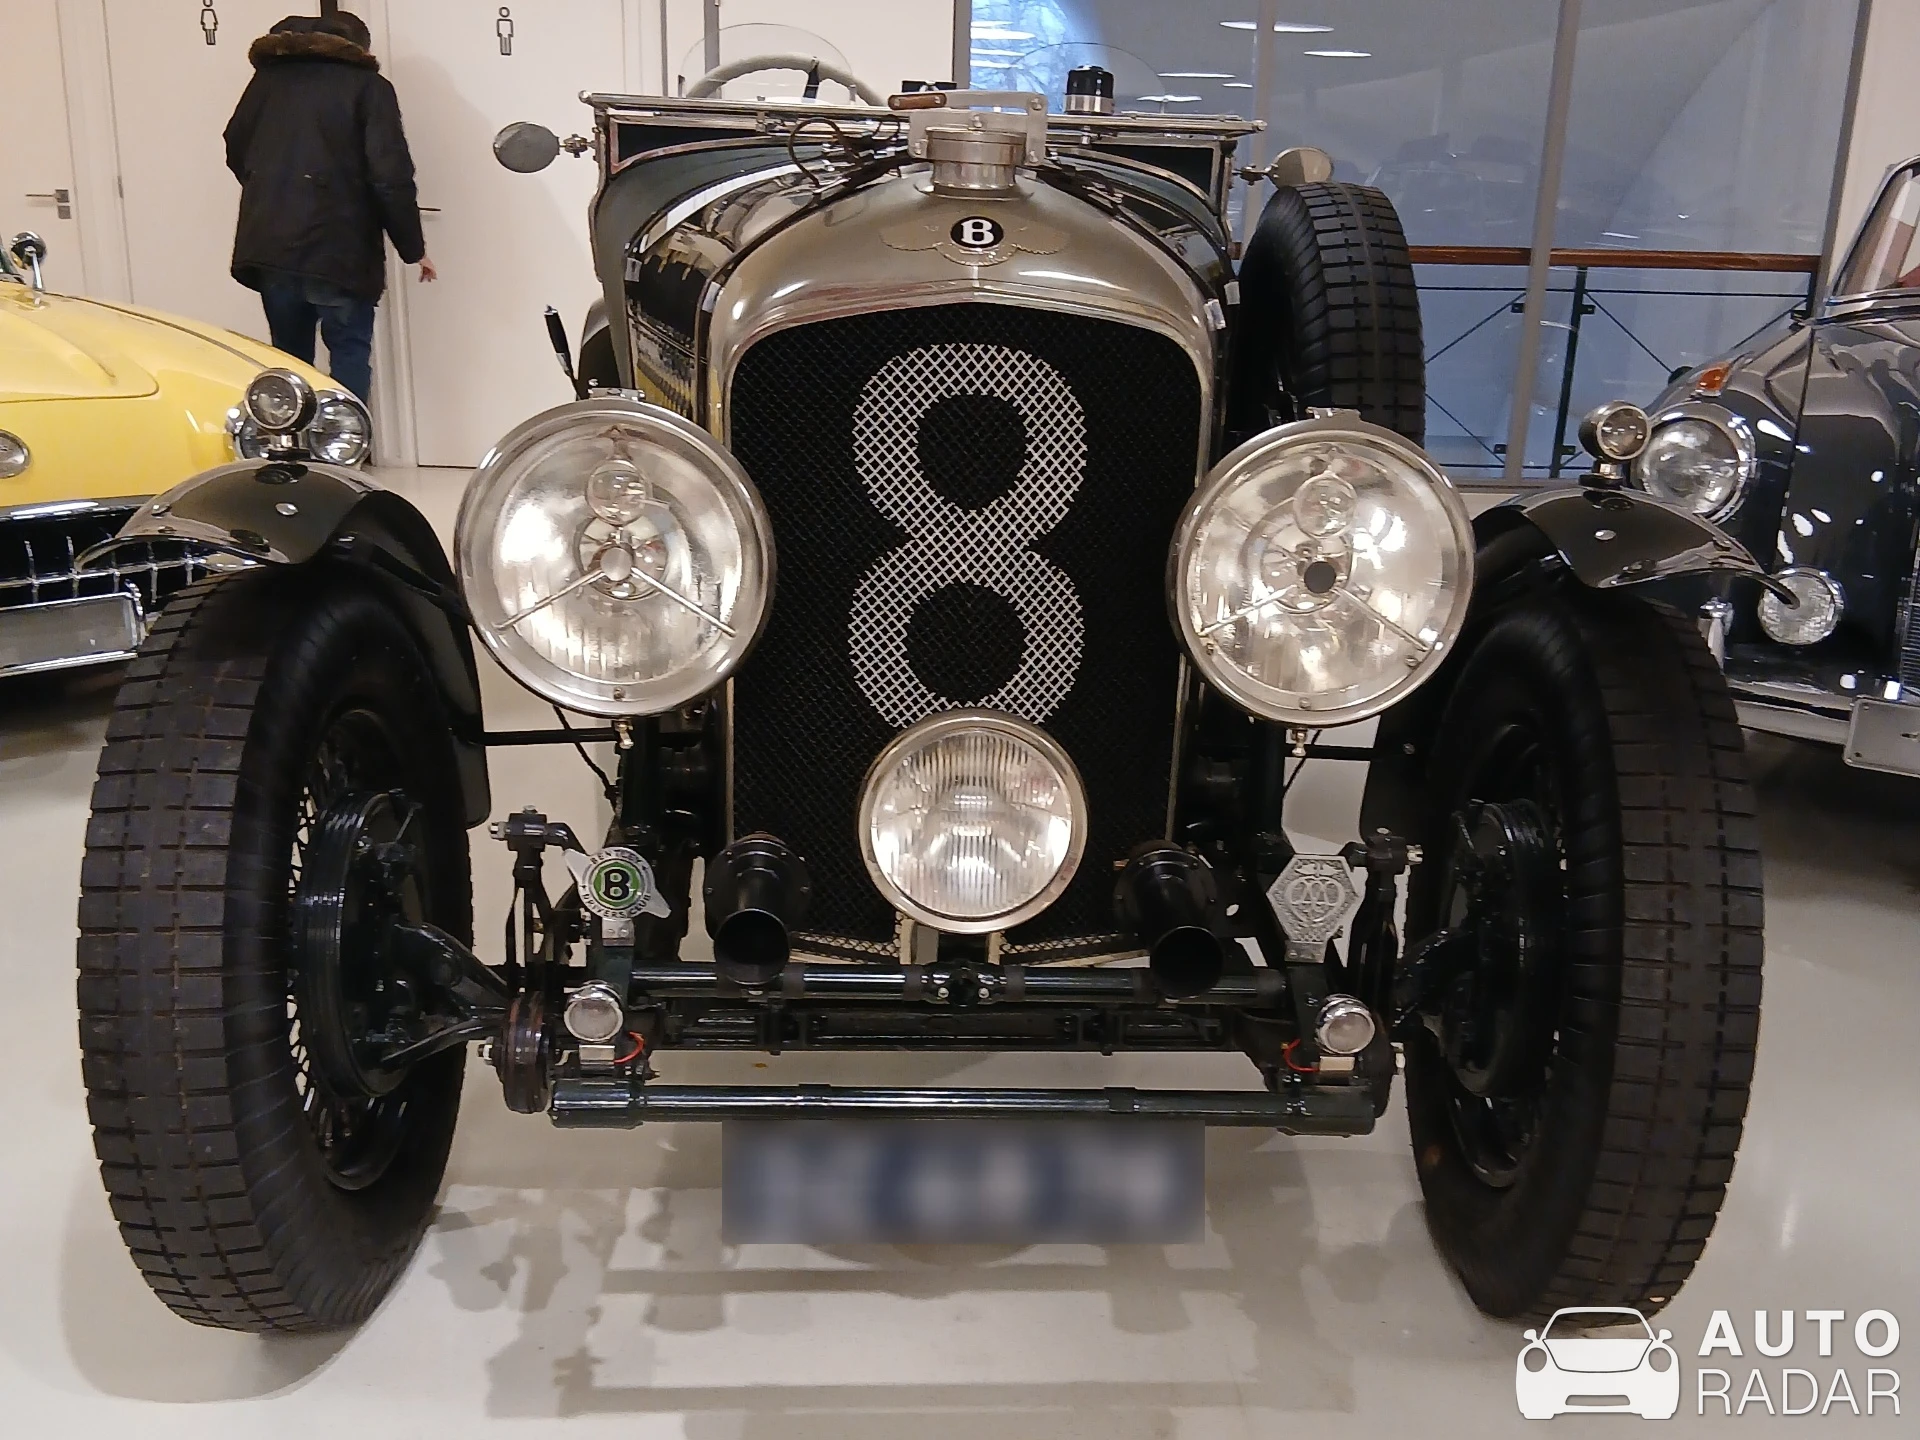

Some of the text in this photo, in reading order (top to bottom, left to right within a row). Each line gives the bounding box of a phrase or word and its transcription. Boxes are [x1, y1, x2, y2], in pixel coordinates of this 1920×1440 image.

[960, 218, 995, 246] B
[848, 342, 1088, 729] 8
[589, 849, 644, 865] BENTLEY
[602, 868, 631, 901] B
